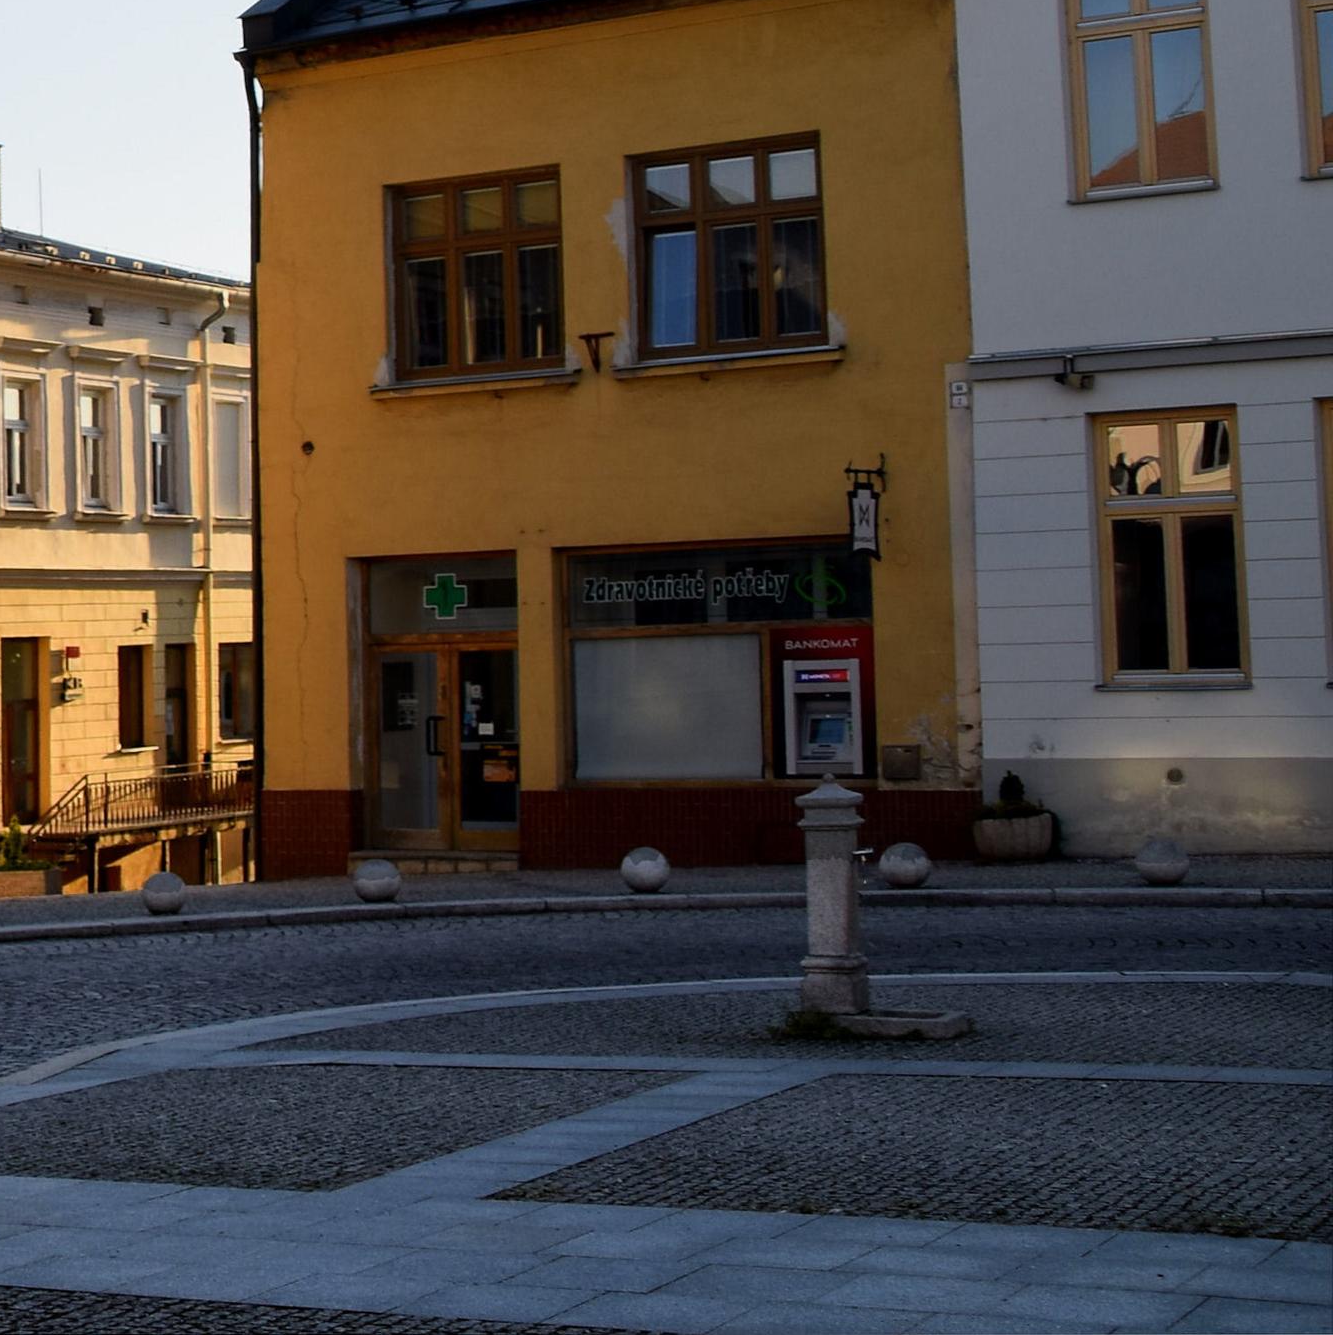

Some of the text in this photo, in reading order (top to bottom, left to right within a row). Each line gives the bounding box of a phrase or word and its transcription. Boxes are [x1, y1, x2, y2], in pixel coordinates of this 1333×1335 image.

[583, 567, 789, 605] Zdravotnické potřeby
[784, 638, 860, 650] BANKOMAT
